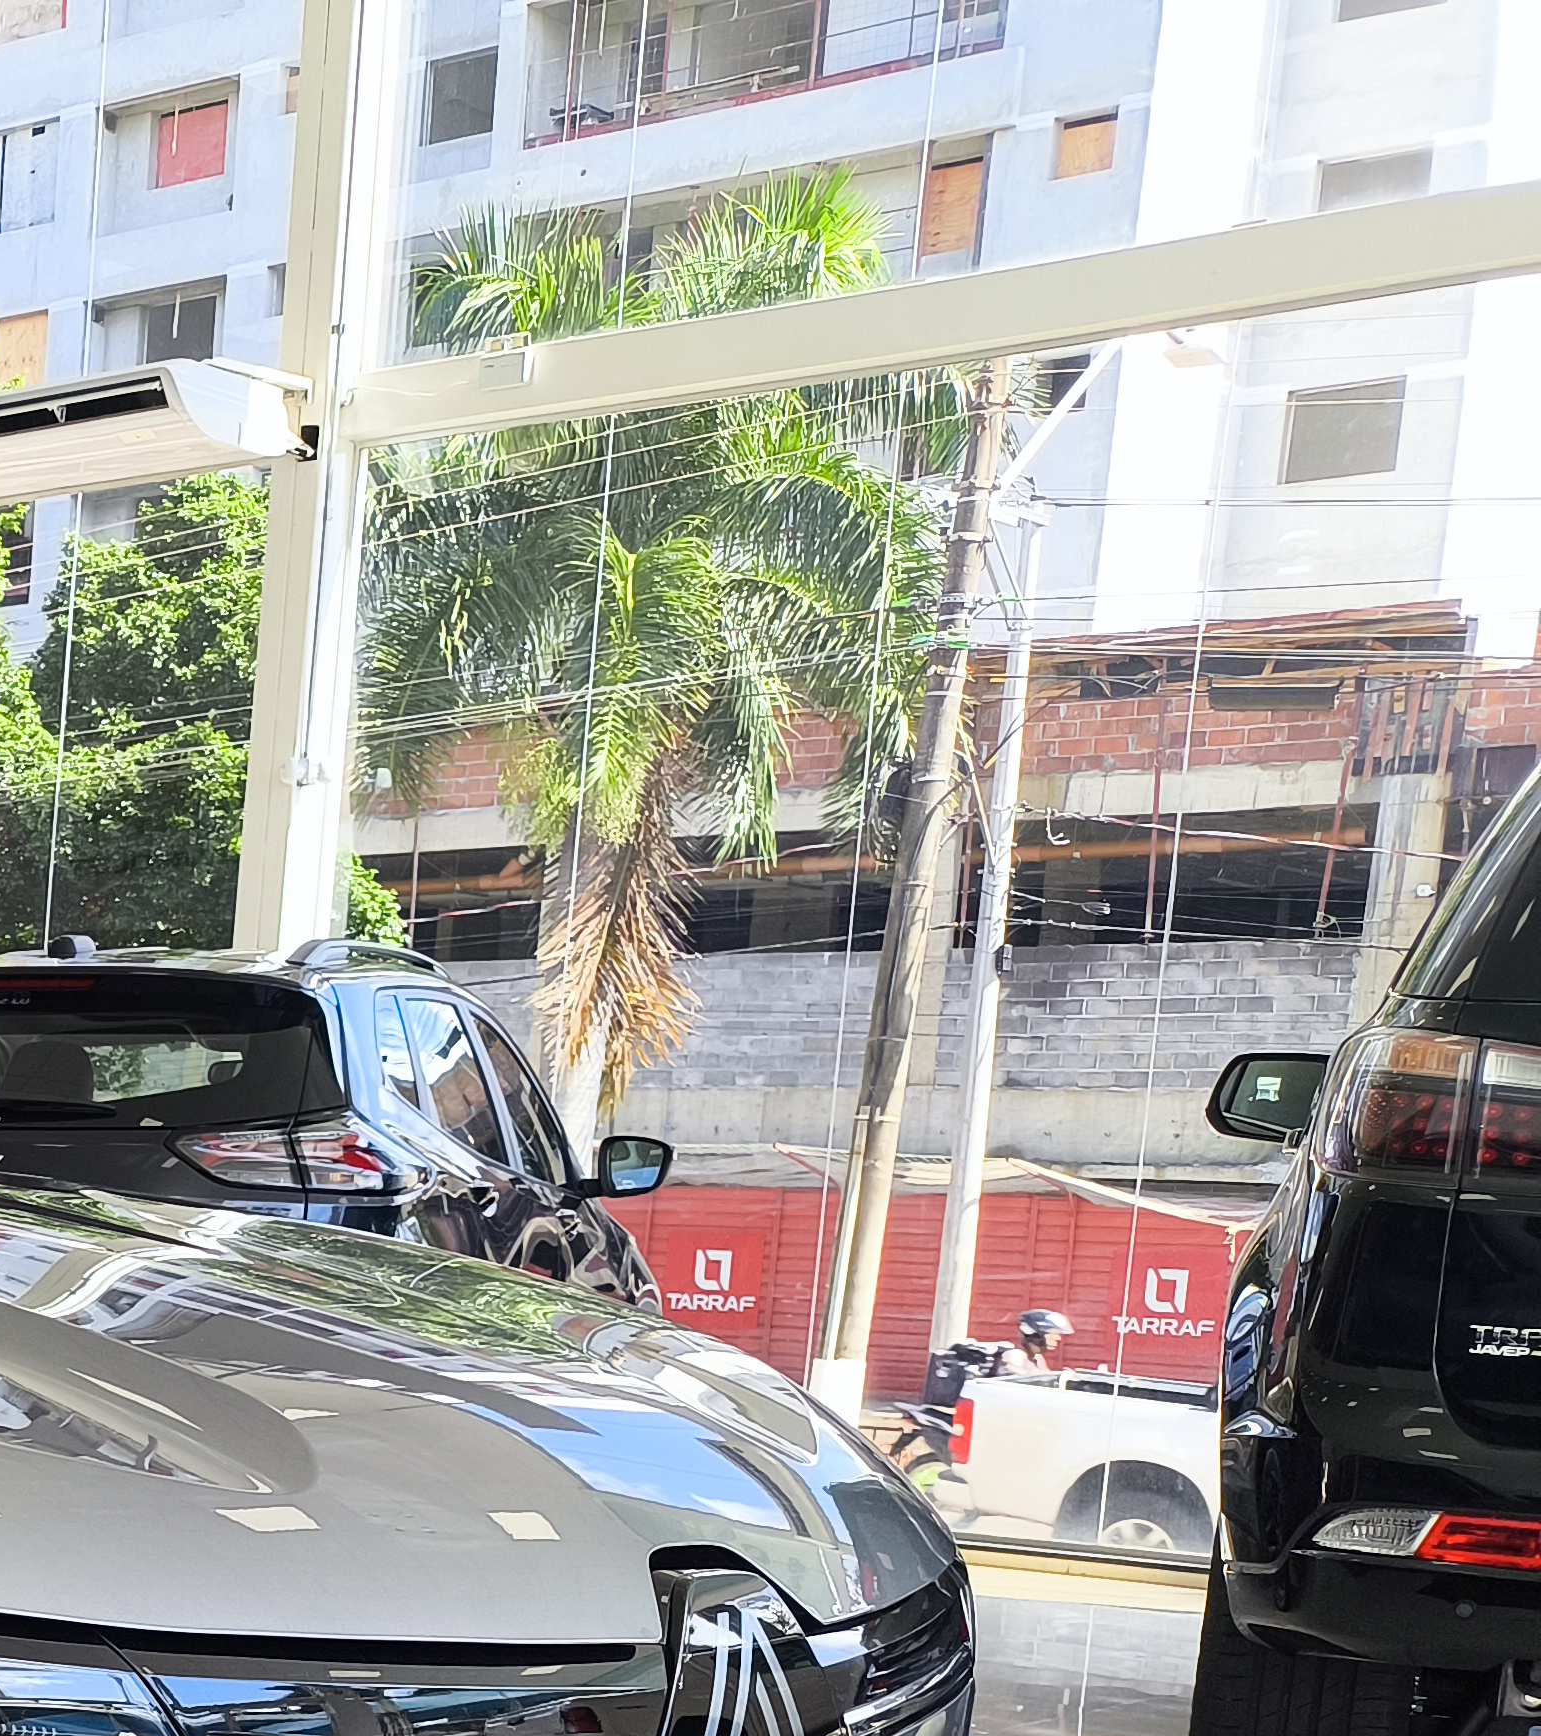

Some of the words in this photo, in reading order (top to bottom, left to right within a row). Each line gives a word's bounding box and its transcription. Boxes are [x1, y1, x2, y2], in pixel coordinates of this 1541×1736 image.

[666, 1292, 756, 1313] TARRAF
[1111, 1315, 1216, 1337] TARRAF
[1468, 1343, 1531, 1357] JAVEP
